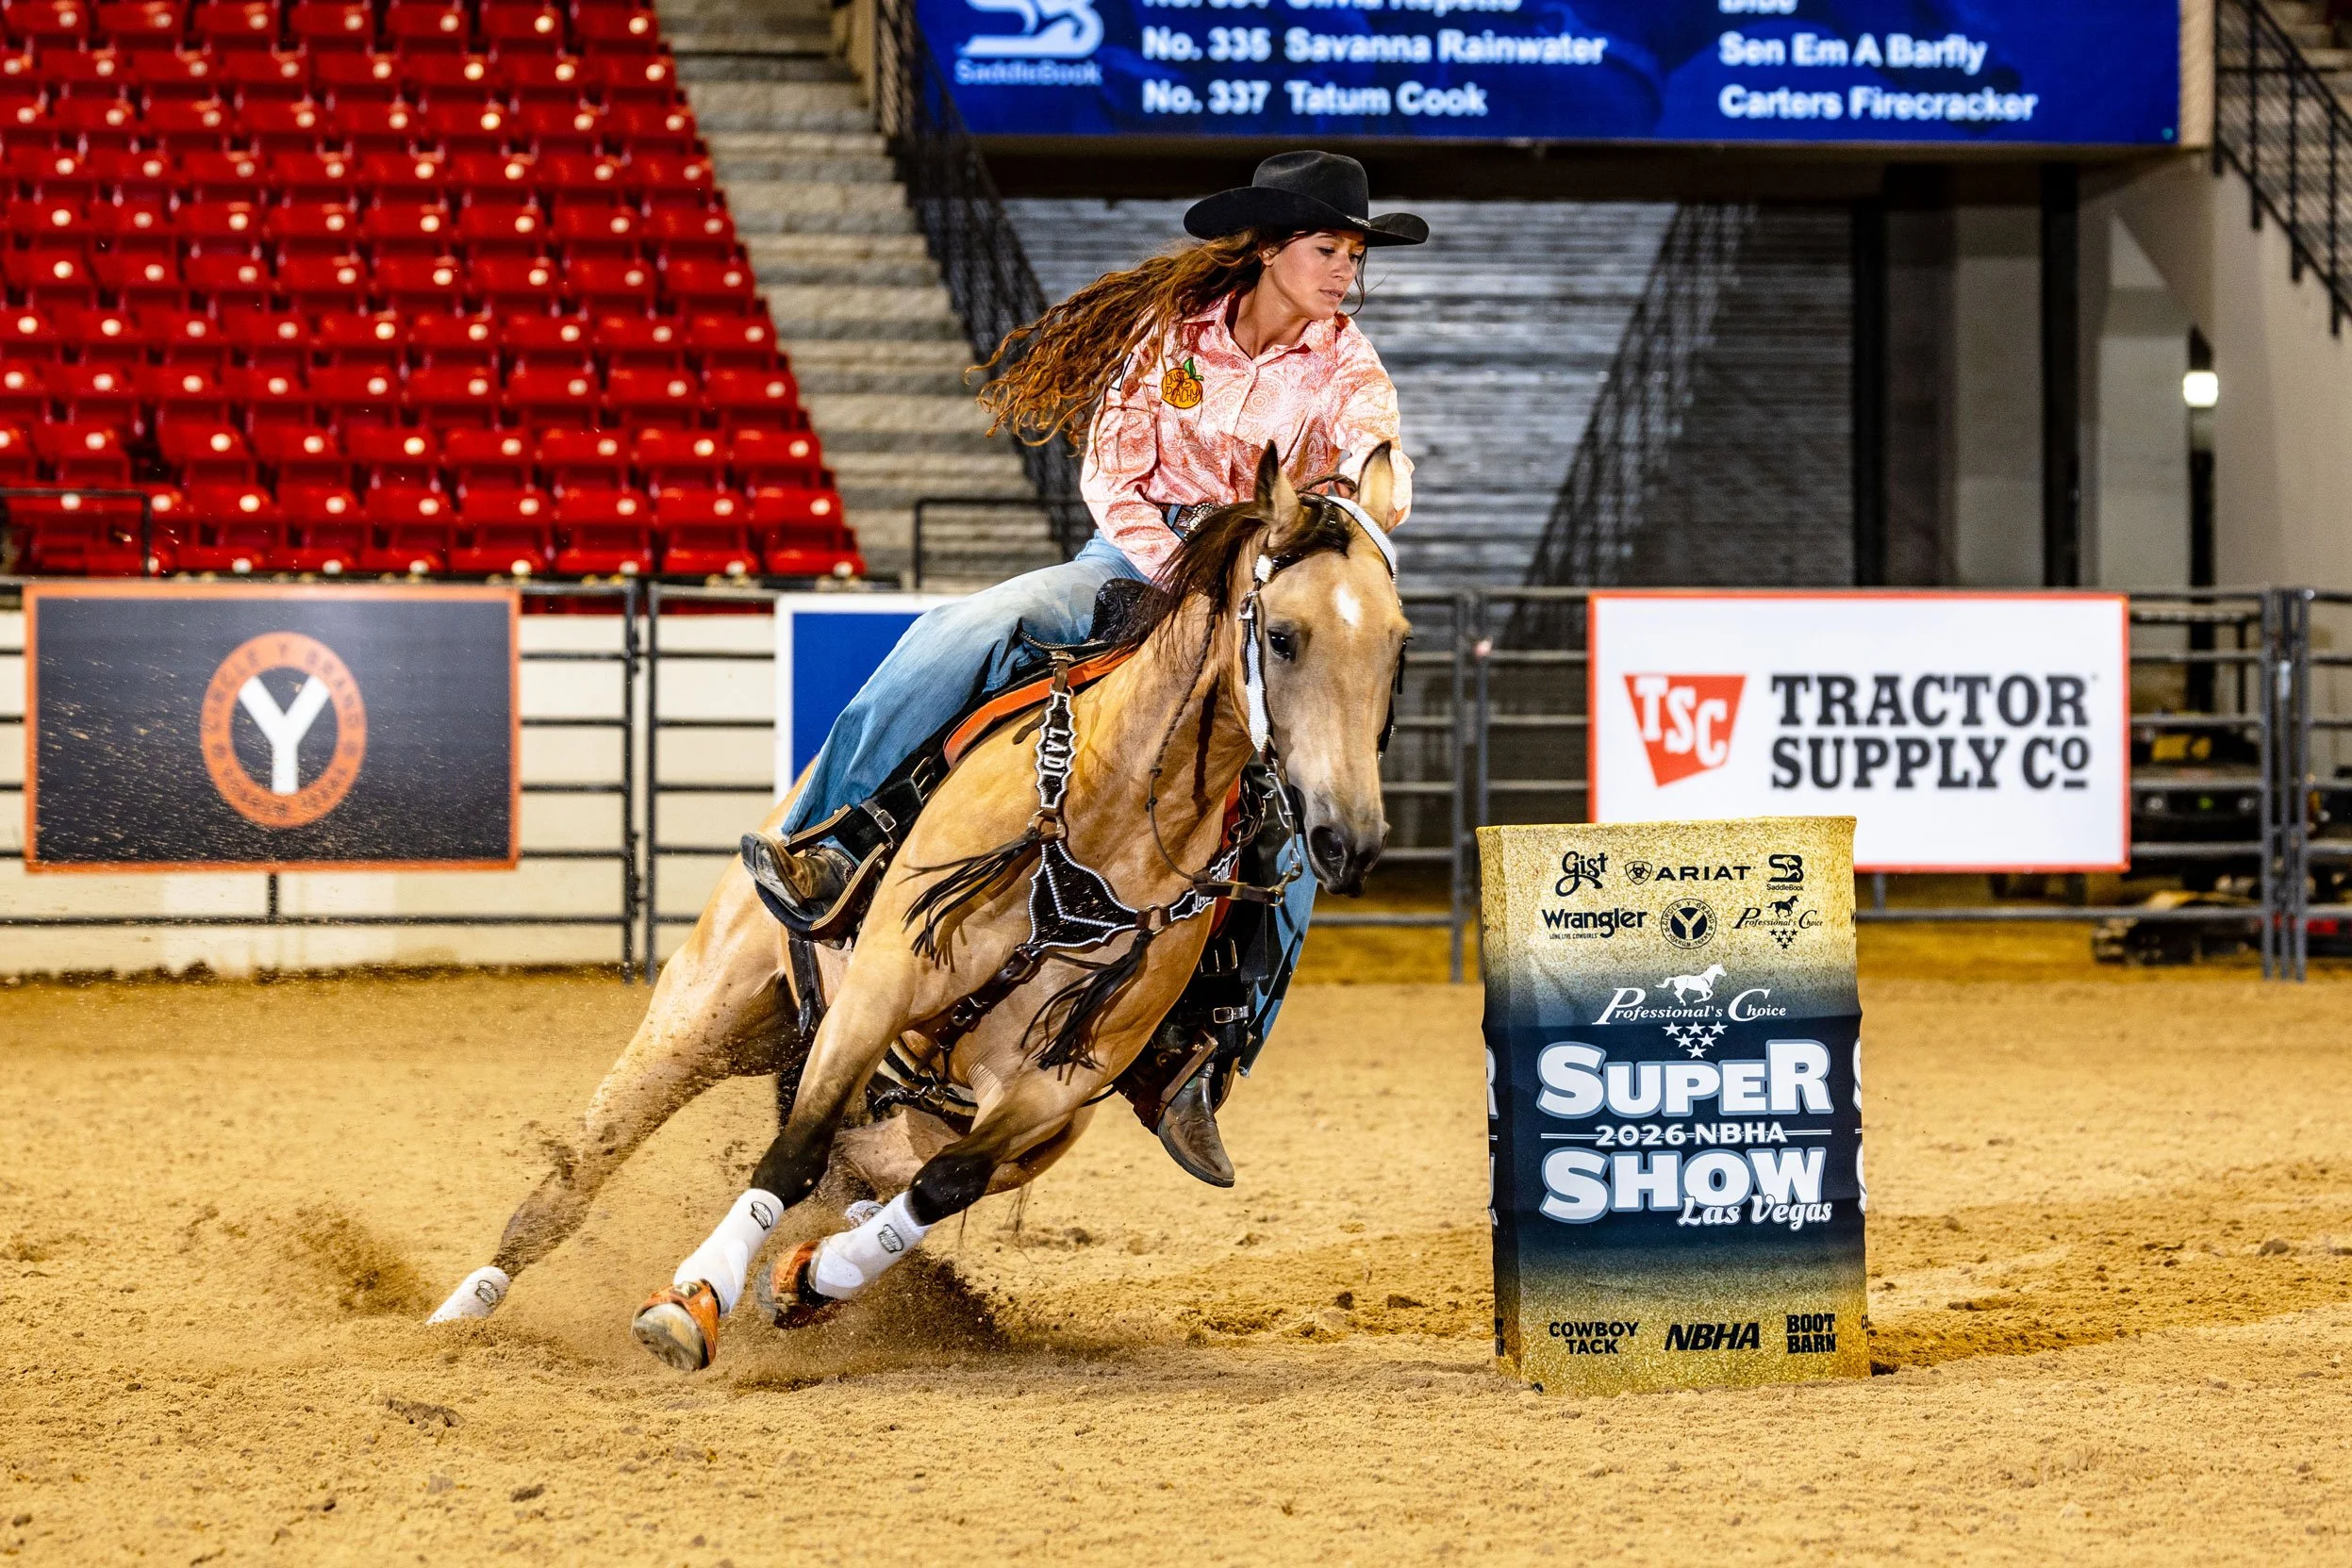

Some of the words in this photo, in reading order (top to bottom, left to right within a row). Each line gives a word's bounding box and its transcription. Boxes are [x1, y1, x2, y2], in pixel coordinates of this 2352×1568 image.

[1142, 26, 1202, 60] No.
[1208, 27, 1271, 61] 335
[1284, 27, 1432, 62] Savanna
[1437, 29, 1608, 63] Rainwater
[1792, 33, 1848, 66] Em
[1852, 33, 1883, 67] A
[1886, 34, 1988, 74] Barfly
[1142, 79, 1202, 113] No.
[1208, 79, 1271, 114] 337
[1284, 80, 1391, 114] Tatum
[1396, 81, 1488, 115] Cook
[1719, 84, 1843, 119] Carters
[1848, 86, 2039, 121] Firecracker
[1771, 674, 2089, 727] TRACTOR
[239, 675, 330, 794] Y
[1633, 676, 1728, 768] TSC
[1771, 737, 2006, 789] SUPPLY
[1655, 866, 1751, 881] ARIAT
[1541, 908, 1647, 938] Wrangler
[1663, 903, 1682, 925] CIRCLE
[1697, 903, 1714, 924] BRAND
[1732, 907, 1797, 929] Professional's
[1798, 910, 1823, 929] Choice
[1592, 987, 1723, 1026] Professional's
[1728, 988, 1786, 1022] Choice
[1537, 1039, 1834, 1119] SUPER
[1595, 1123, 1686, 1147] 2026
[1695, 1122, 1788, 1146] NBHA
[1539, 1147, 1826, 1224] SHOW
[1677, 1196, 1741, 1227] Las
[1750, 1194, 1832, 1230] Vegas
[1549, 1321, 1639, 1338] COWBOY
[1665, 1322, 1760, 1351] NBHA
[1786, 1312, 1835, 1333] BOOT
[1565, 1338, 1618, 1355] TACK
[1787, 1333, 1836, 1354] BARN
